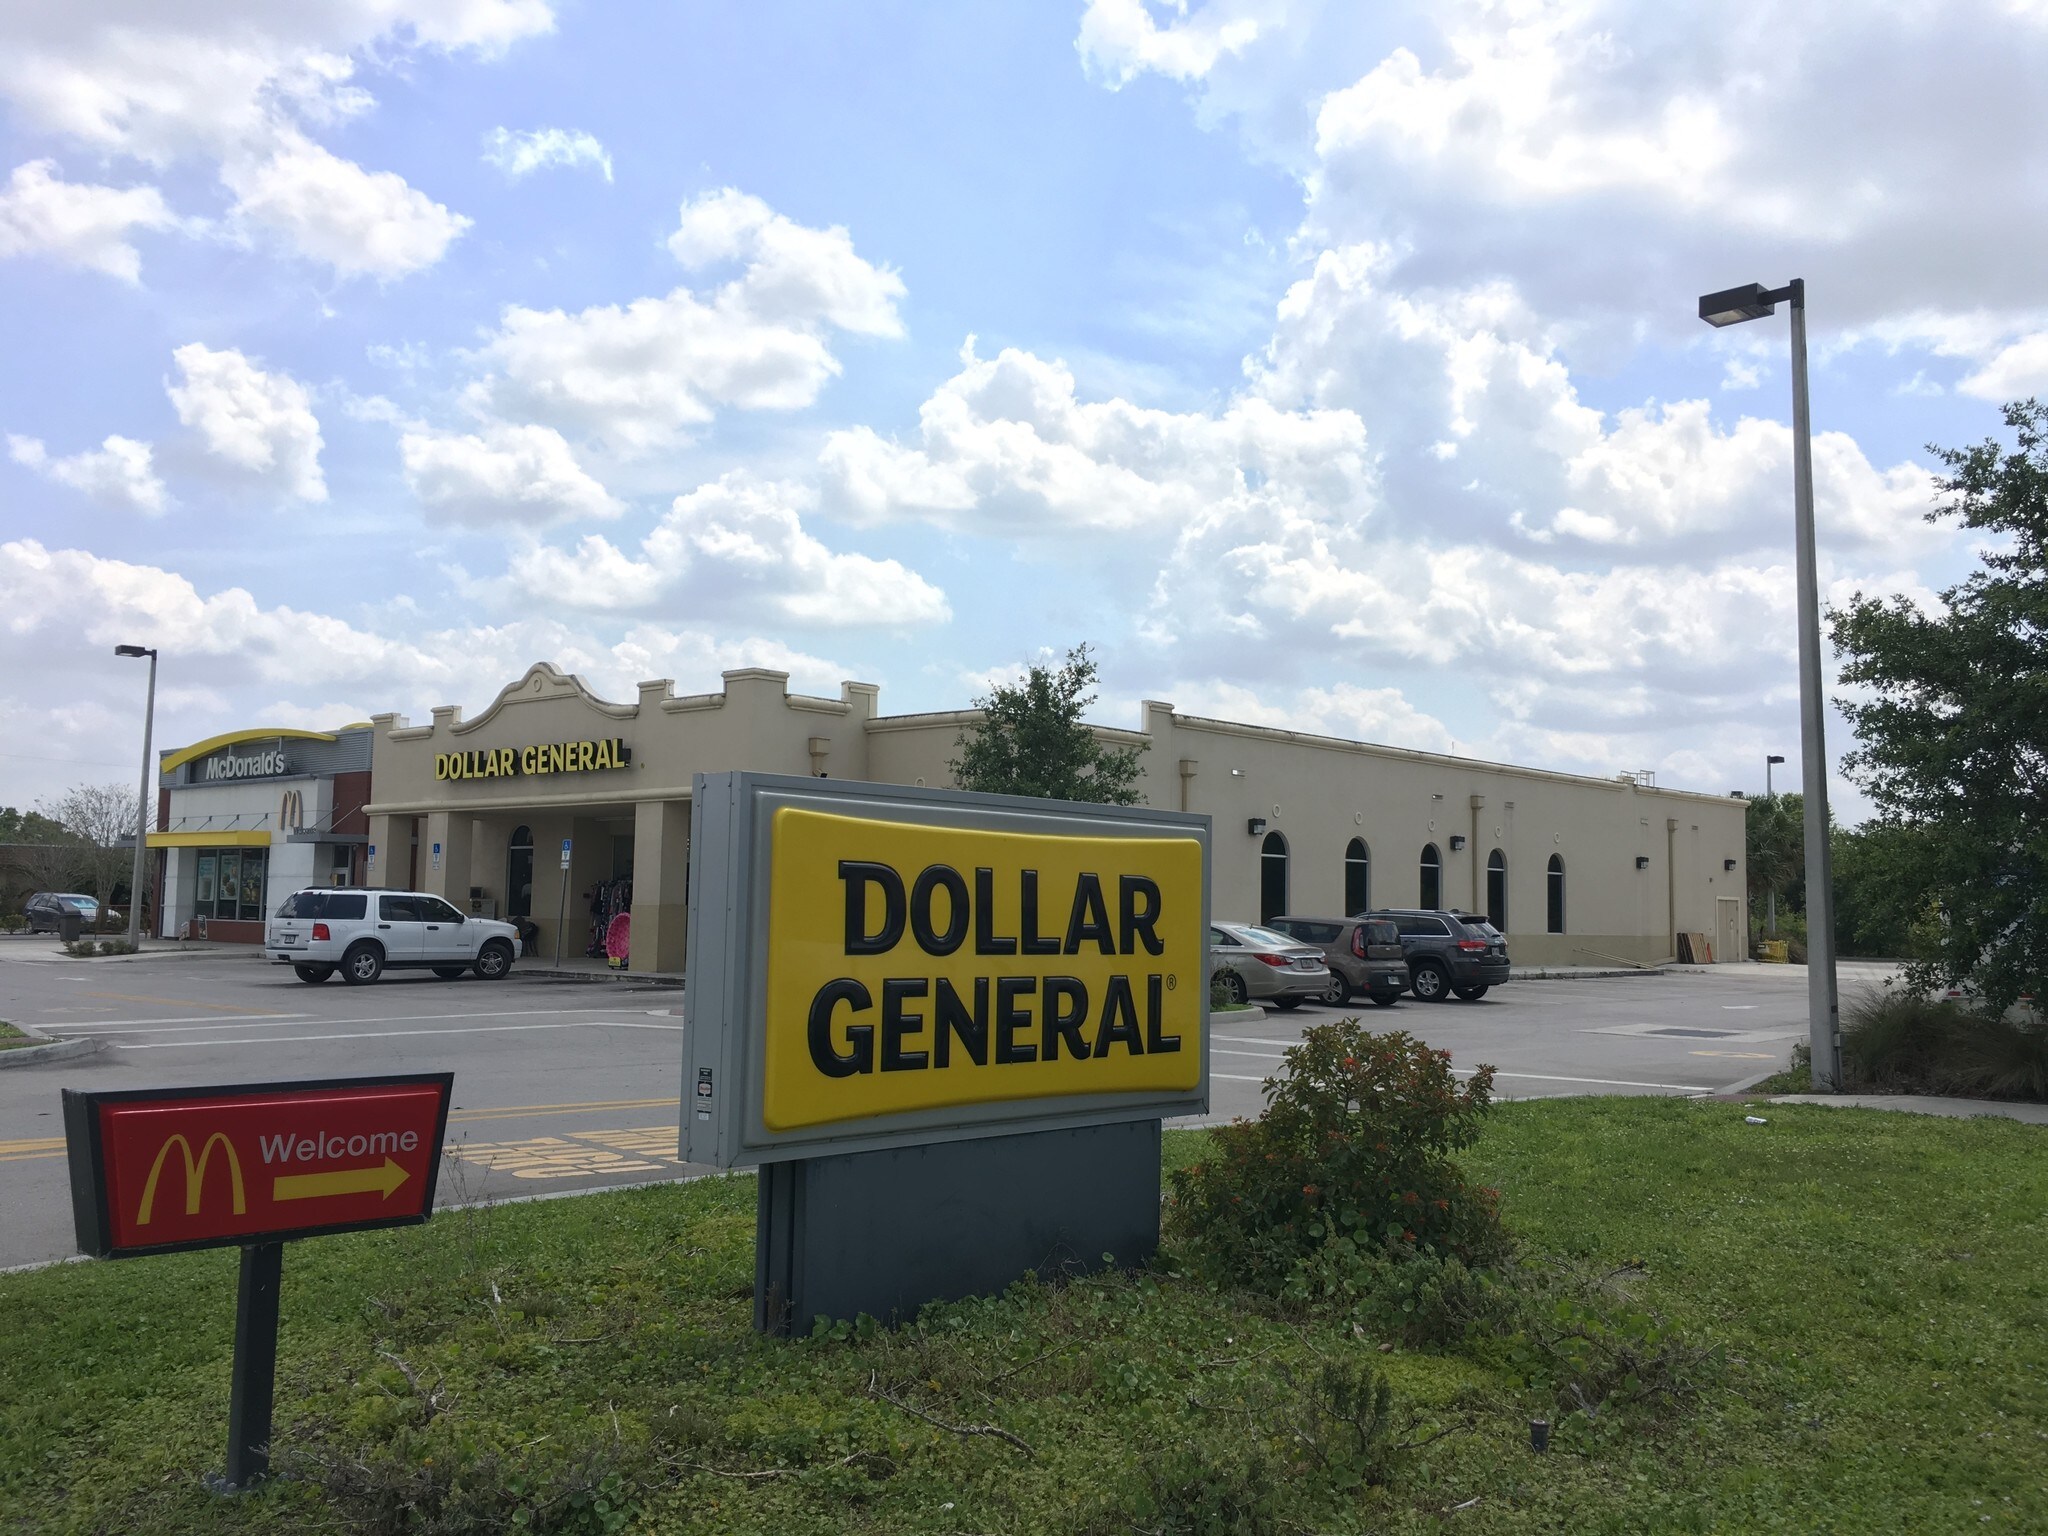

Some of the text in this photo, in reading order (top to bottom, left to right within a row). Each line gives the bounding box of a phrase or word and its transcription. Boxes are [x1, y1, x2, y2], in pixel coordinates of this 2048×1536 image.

[205, 751, 285, 780] McDonald's
[434, 738, 626, 781] DOLLAR GENERAL
[838, 860, 1165, 956] DOLLAR
[259, 1130, 419, 1164] Welcome
